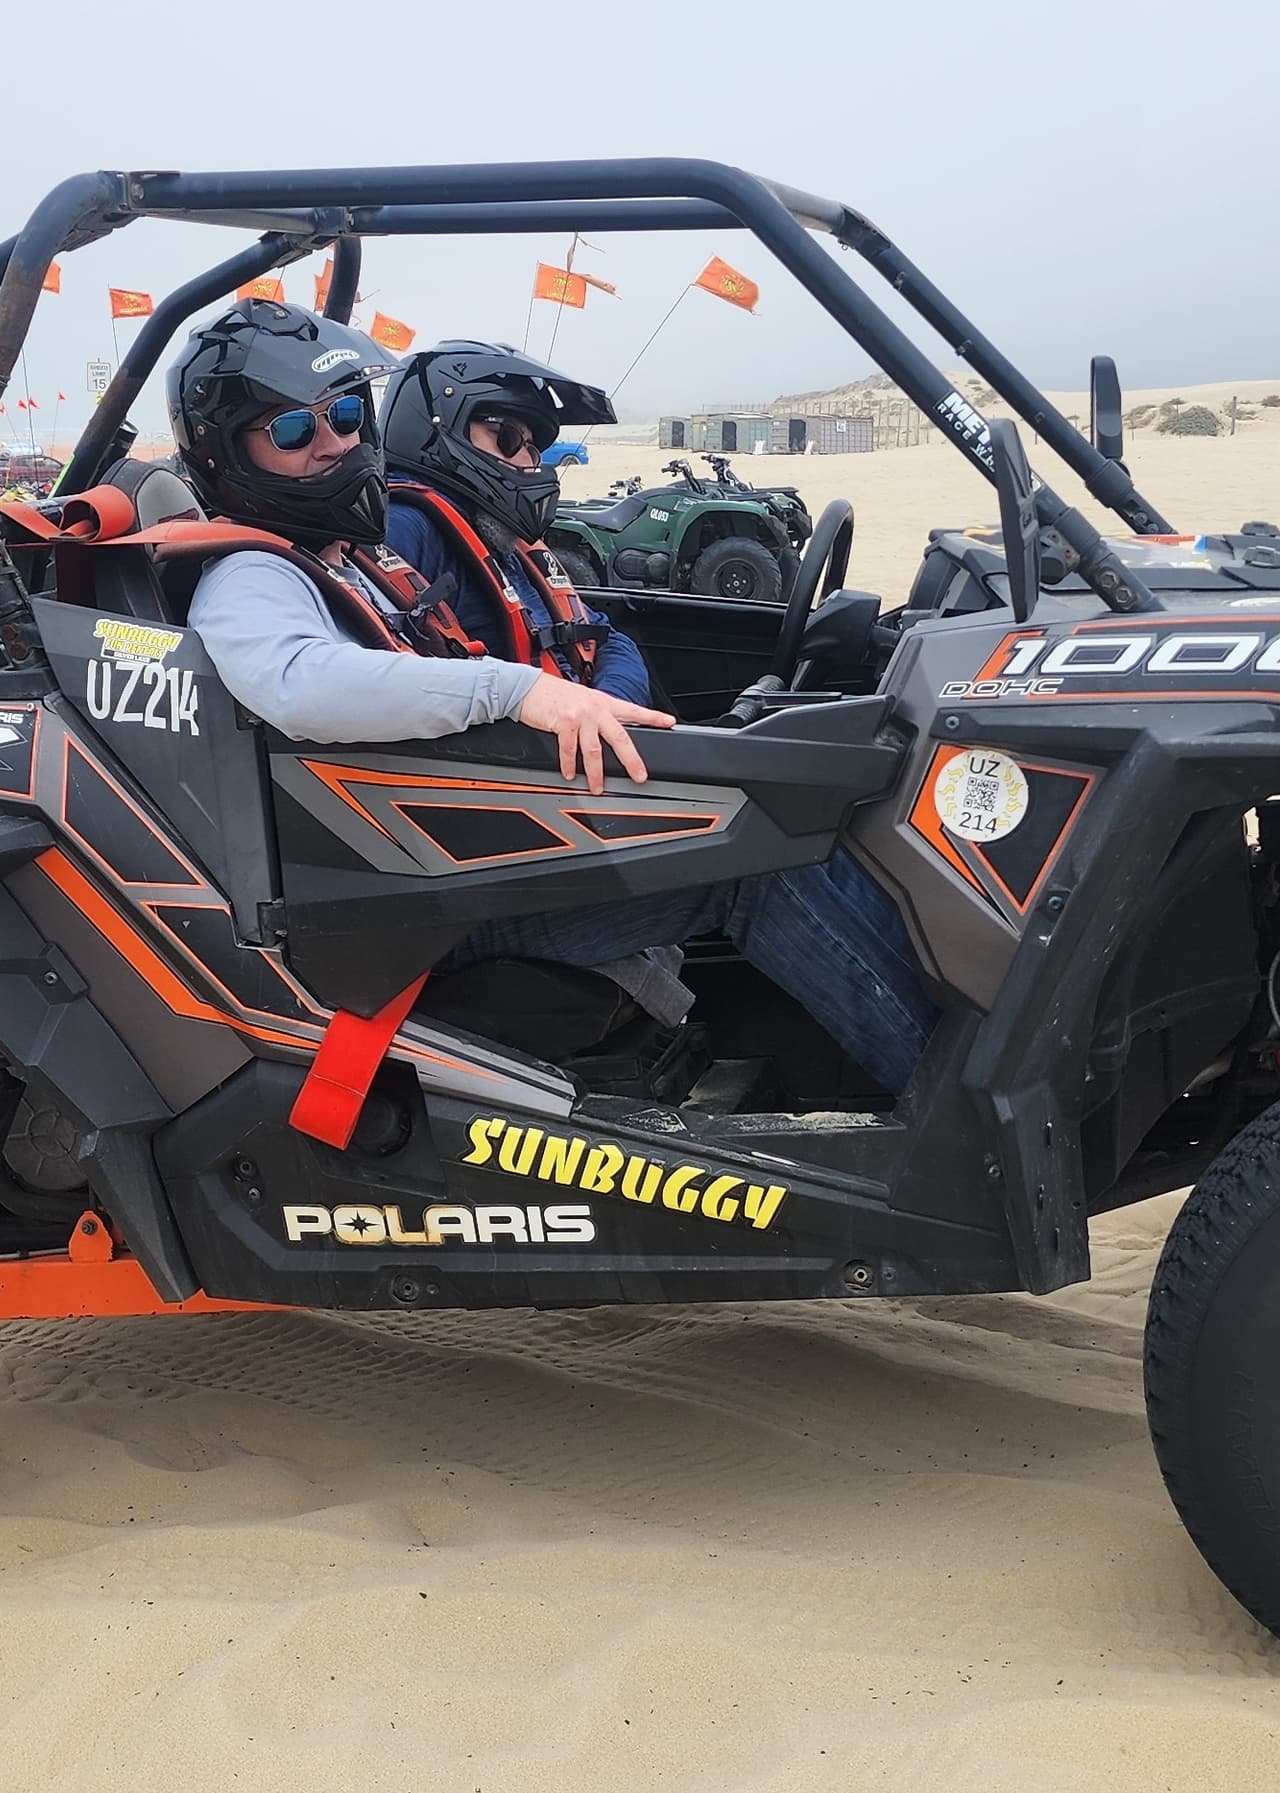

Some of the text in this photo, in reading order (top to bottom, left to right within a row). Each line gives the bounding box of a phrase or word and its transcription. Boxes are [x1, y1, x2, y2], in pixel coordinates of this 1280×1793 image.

[93, 379, 106, 389] 15
[937, 403, 972, 440] RACE
[94, 621, 181, 649] SUNBUGGY
[86, 659, 200, 736] UZ214
[939, 678, 1064, 697] DOHC
[969, 757, 1001, 778] UZ
[959, 811, 999, 833] 214
[463, 1117, 787, 1229] SUNBUGGY
[282, 1206, 595, 1243] POLARIS
